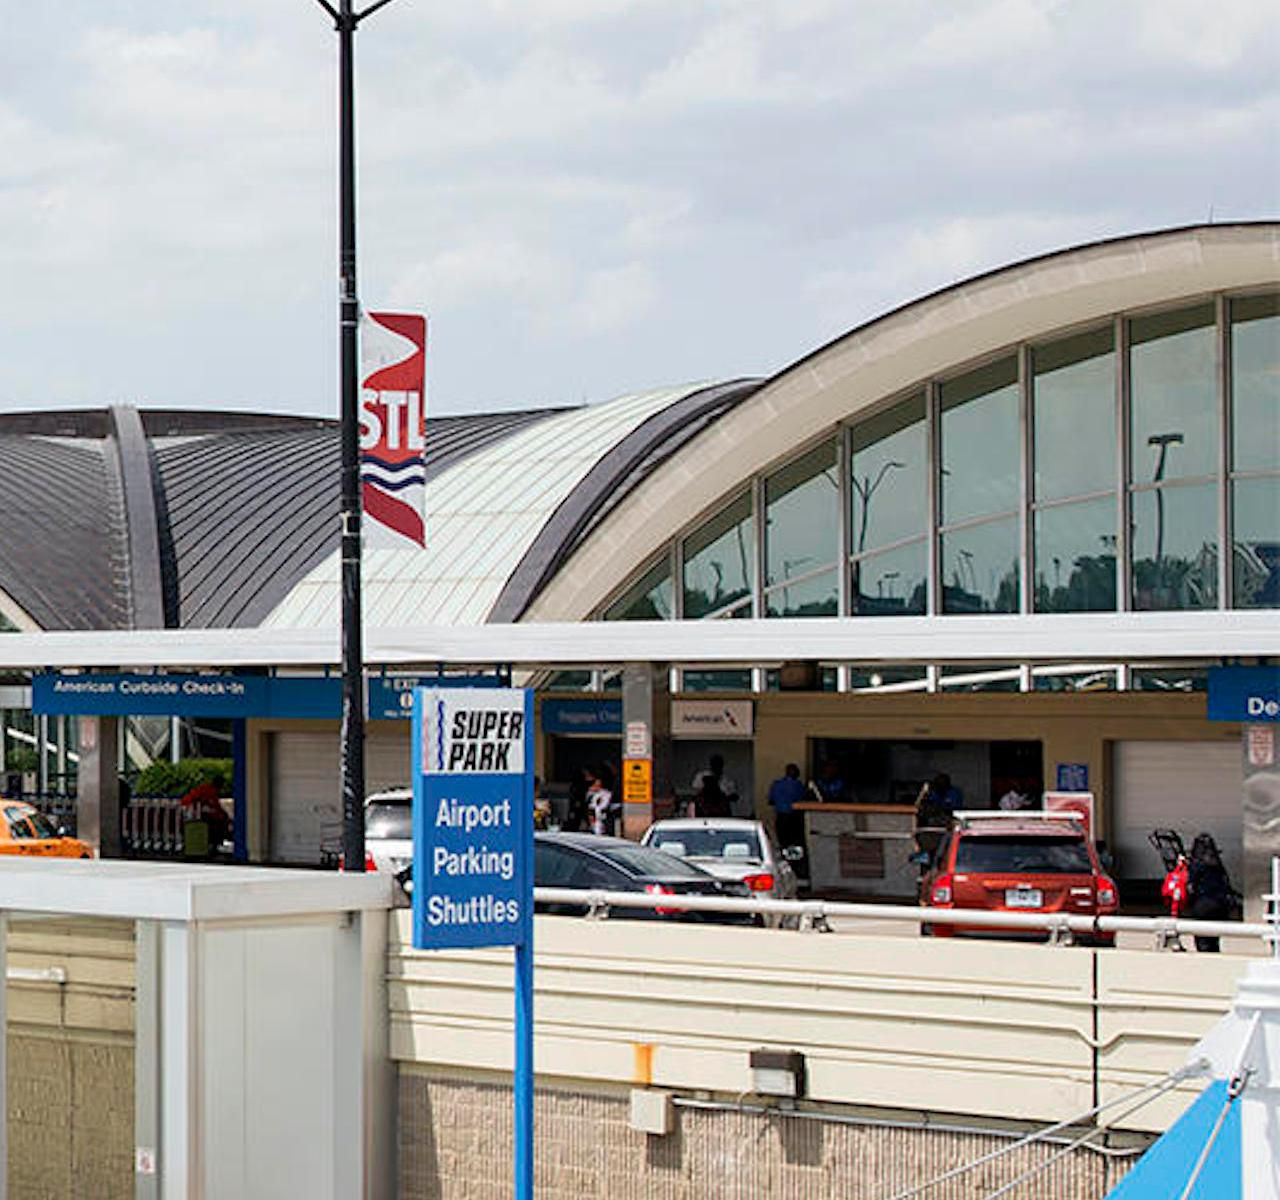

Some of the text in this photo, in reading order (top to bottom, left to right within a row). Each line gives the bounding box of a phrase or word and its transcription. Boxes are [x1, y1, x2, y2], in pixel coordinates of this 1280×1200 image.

[359, 388, 425, 450] STL
[54, 680, 245, 696] American Curbside Check-In
[452, 710, 523, 740] SUPER
[448, 742, 510, 771] PARK
[435, 798, 511, 832] Airport
[433, 845, 514, 880] Parking
[427, 894, 519, 926] Shuttles
